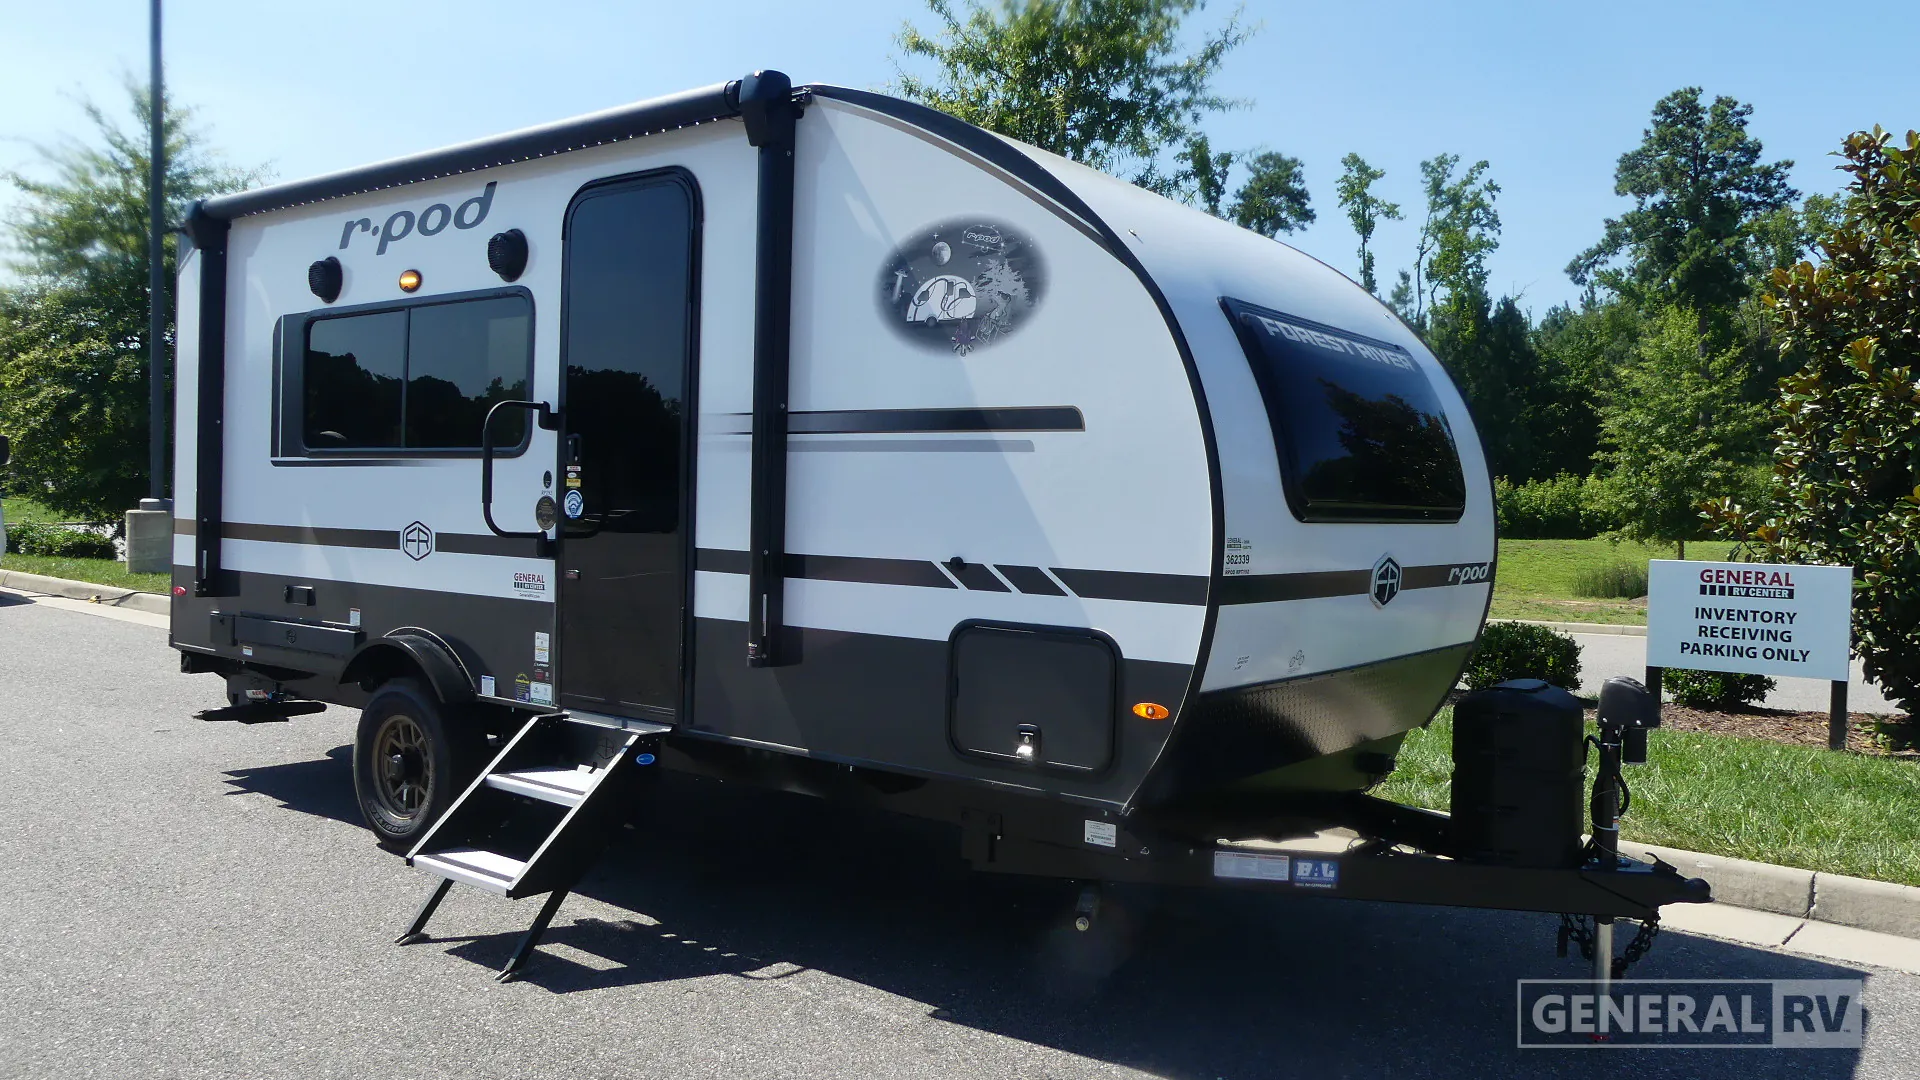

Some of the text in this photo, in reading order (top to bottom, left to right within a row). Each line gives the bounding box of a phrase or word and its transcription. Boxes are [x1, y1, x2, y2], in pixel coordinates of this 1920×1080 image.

[1259, 316, 1415, 372] FOREST RIVER
[514, 572, 545, 583] GENERAL
[1700, 568, 1795, 587] GENERAL
[1732, 587, 1789, 598] RV CENTER
[1694, 606, 1797, 625] INVENTORY
[1698, 625, 1793, 643] RECEIVING
[1680, 641, 1811, 663] PARKING ONLY
